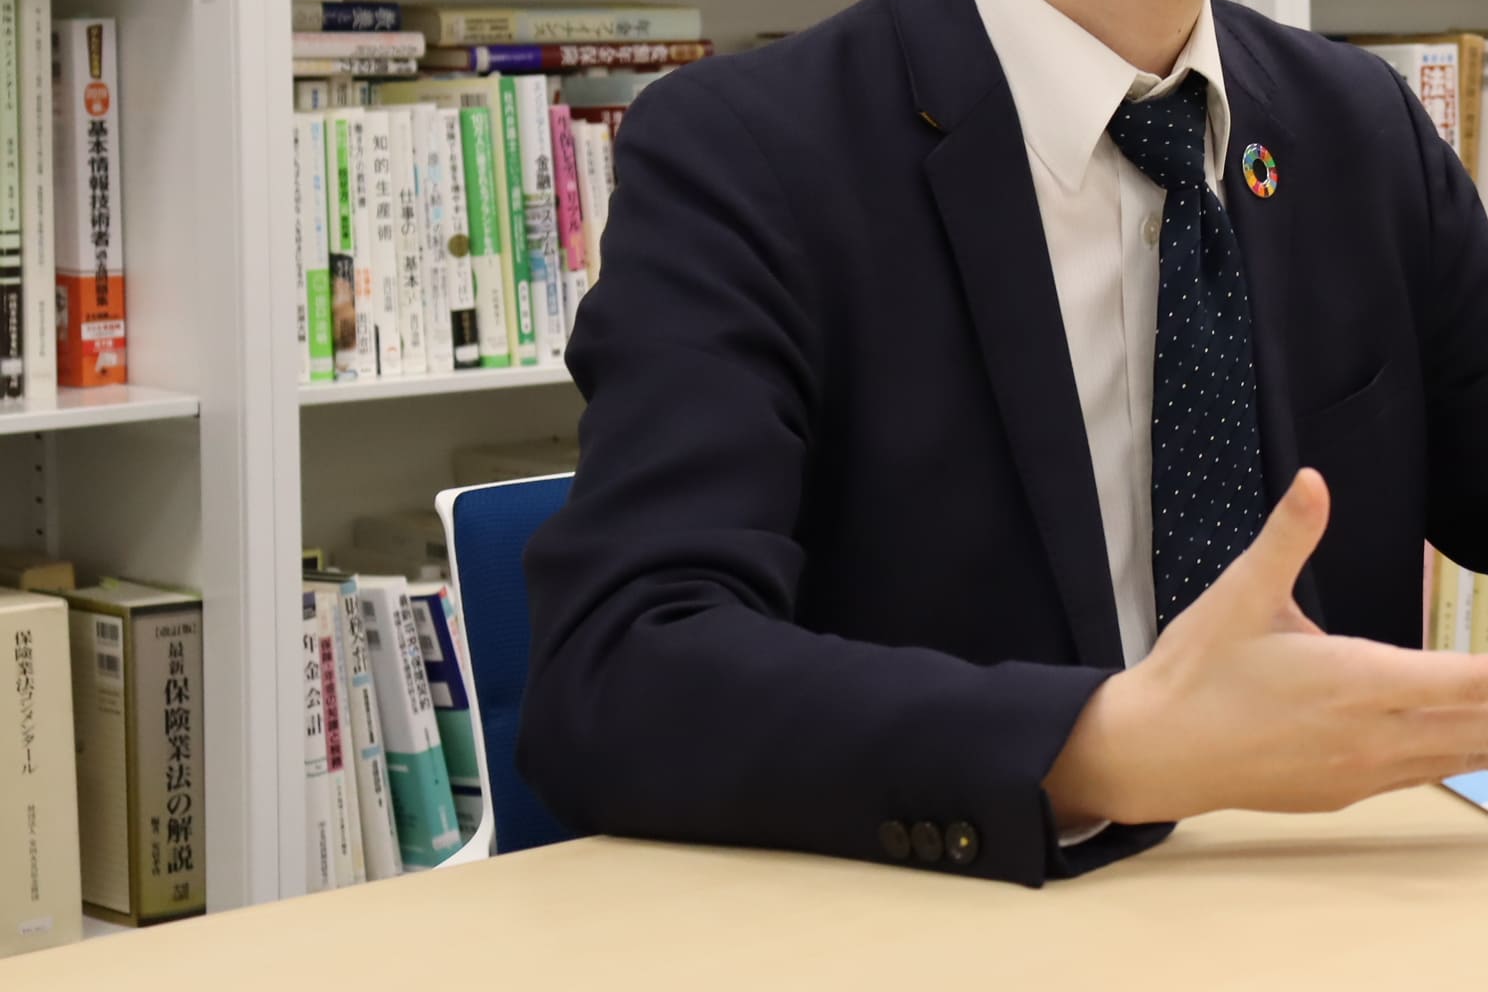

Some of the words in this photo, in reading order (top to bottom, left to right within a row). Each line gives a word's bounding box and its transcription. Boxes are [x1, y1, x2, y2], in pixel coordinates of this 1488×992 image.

[374, 135, 391, 241] 知的生産術
[303, 632, 322, 736] 年金会計
